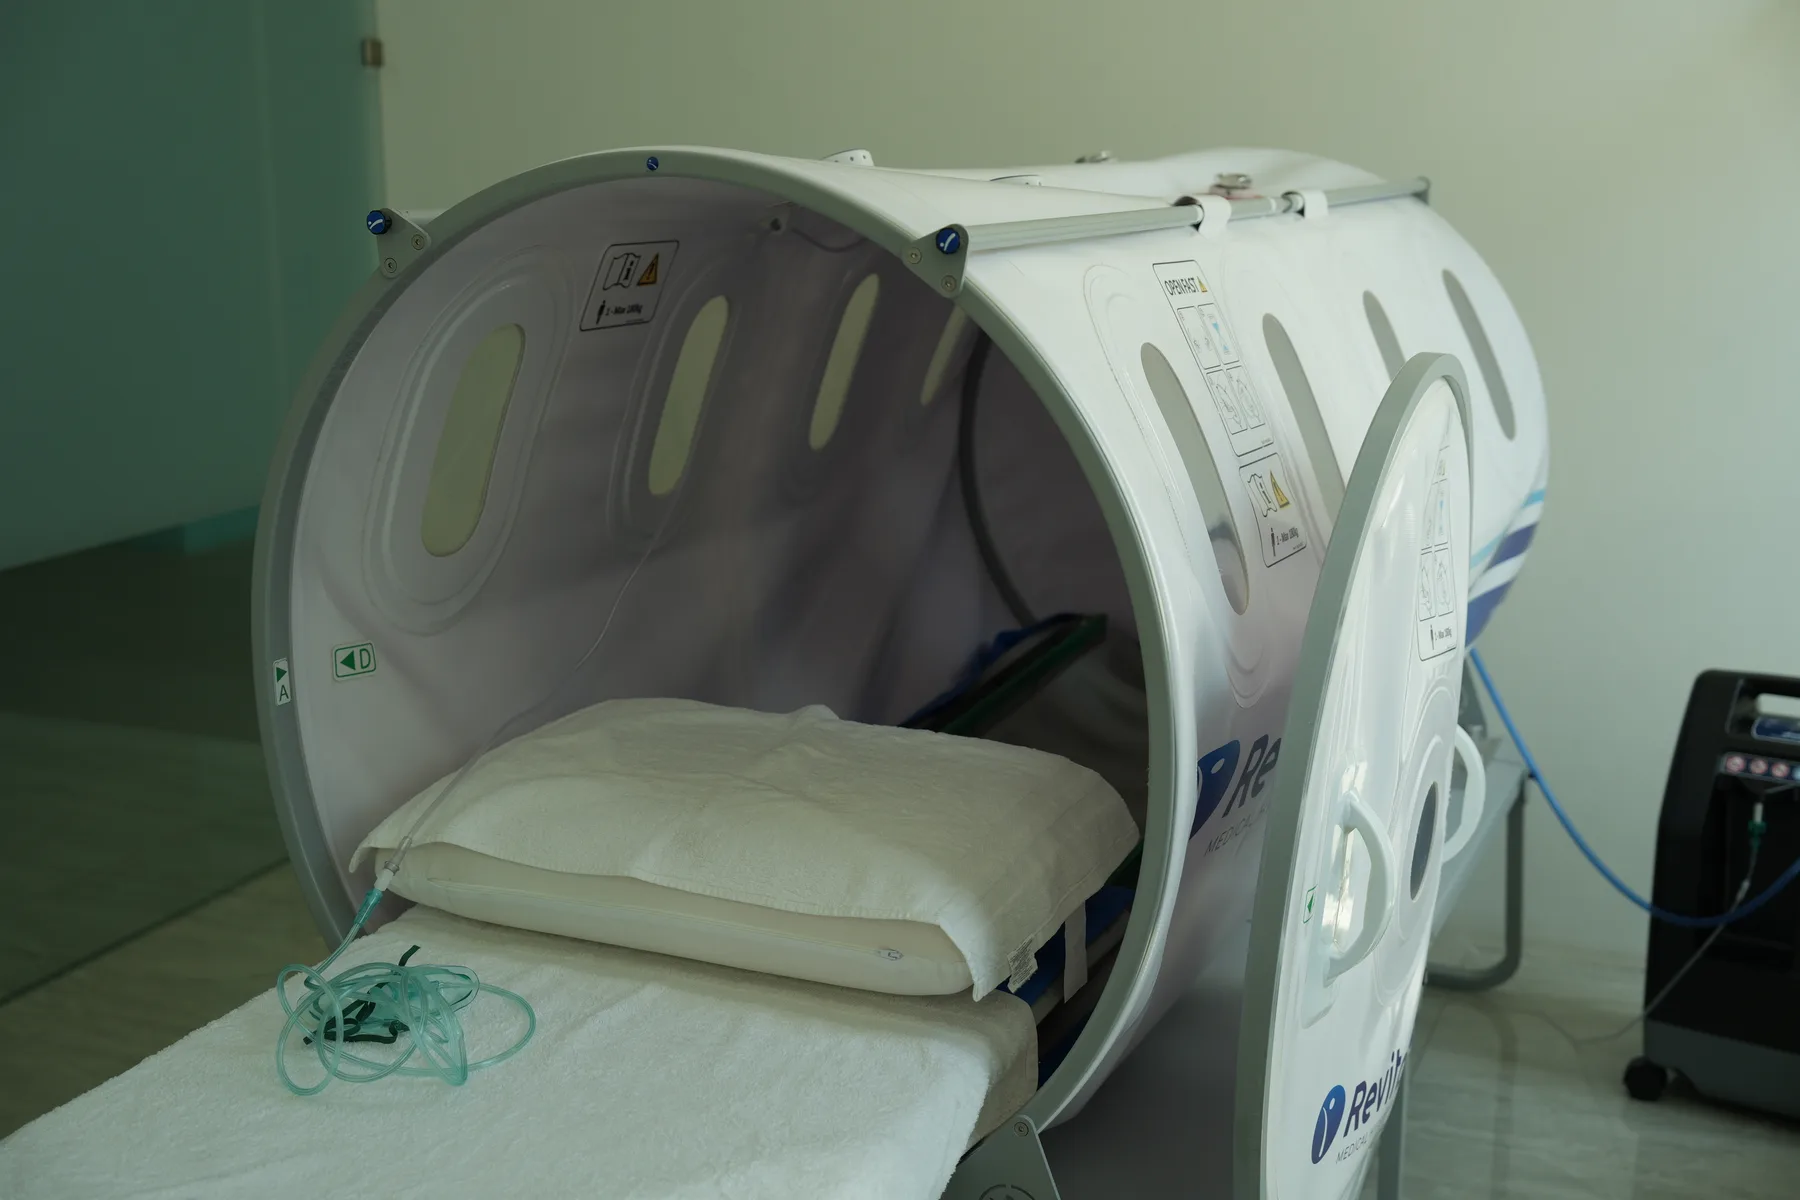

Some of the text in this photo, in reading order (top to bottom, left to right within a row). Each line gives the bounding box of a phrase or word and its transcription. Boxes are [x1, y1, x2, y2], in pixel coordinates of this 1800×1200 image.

[359, 648, 372, 670] D
[279, 684, 289, 702] A
[1203, 814, 1252, 857] MEDICAL
[1335, 1133, 1368, 1164] MEDICAL
